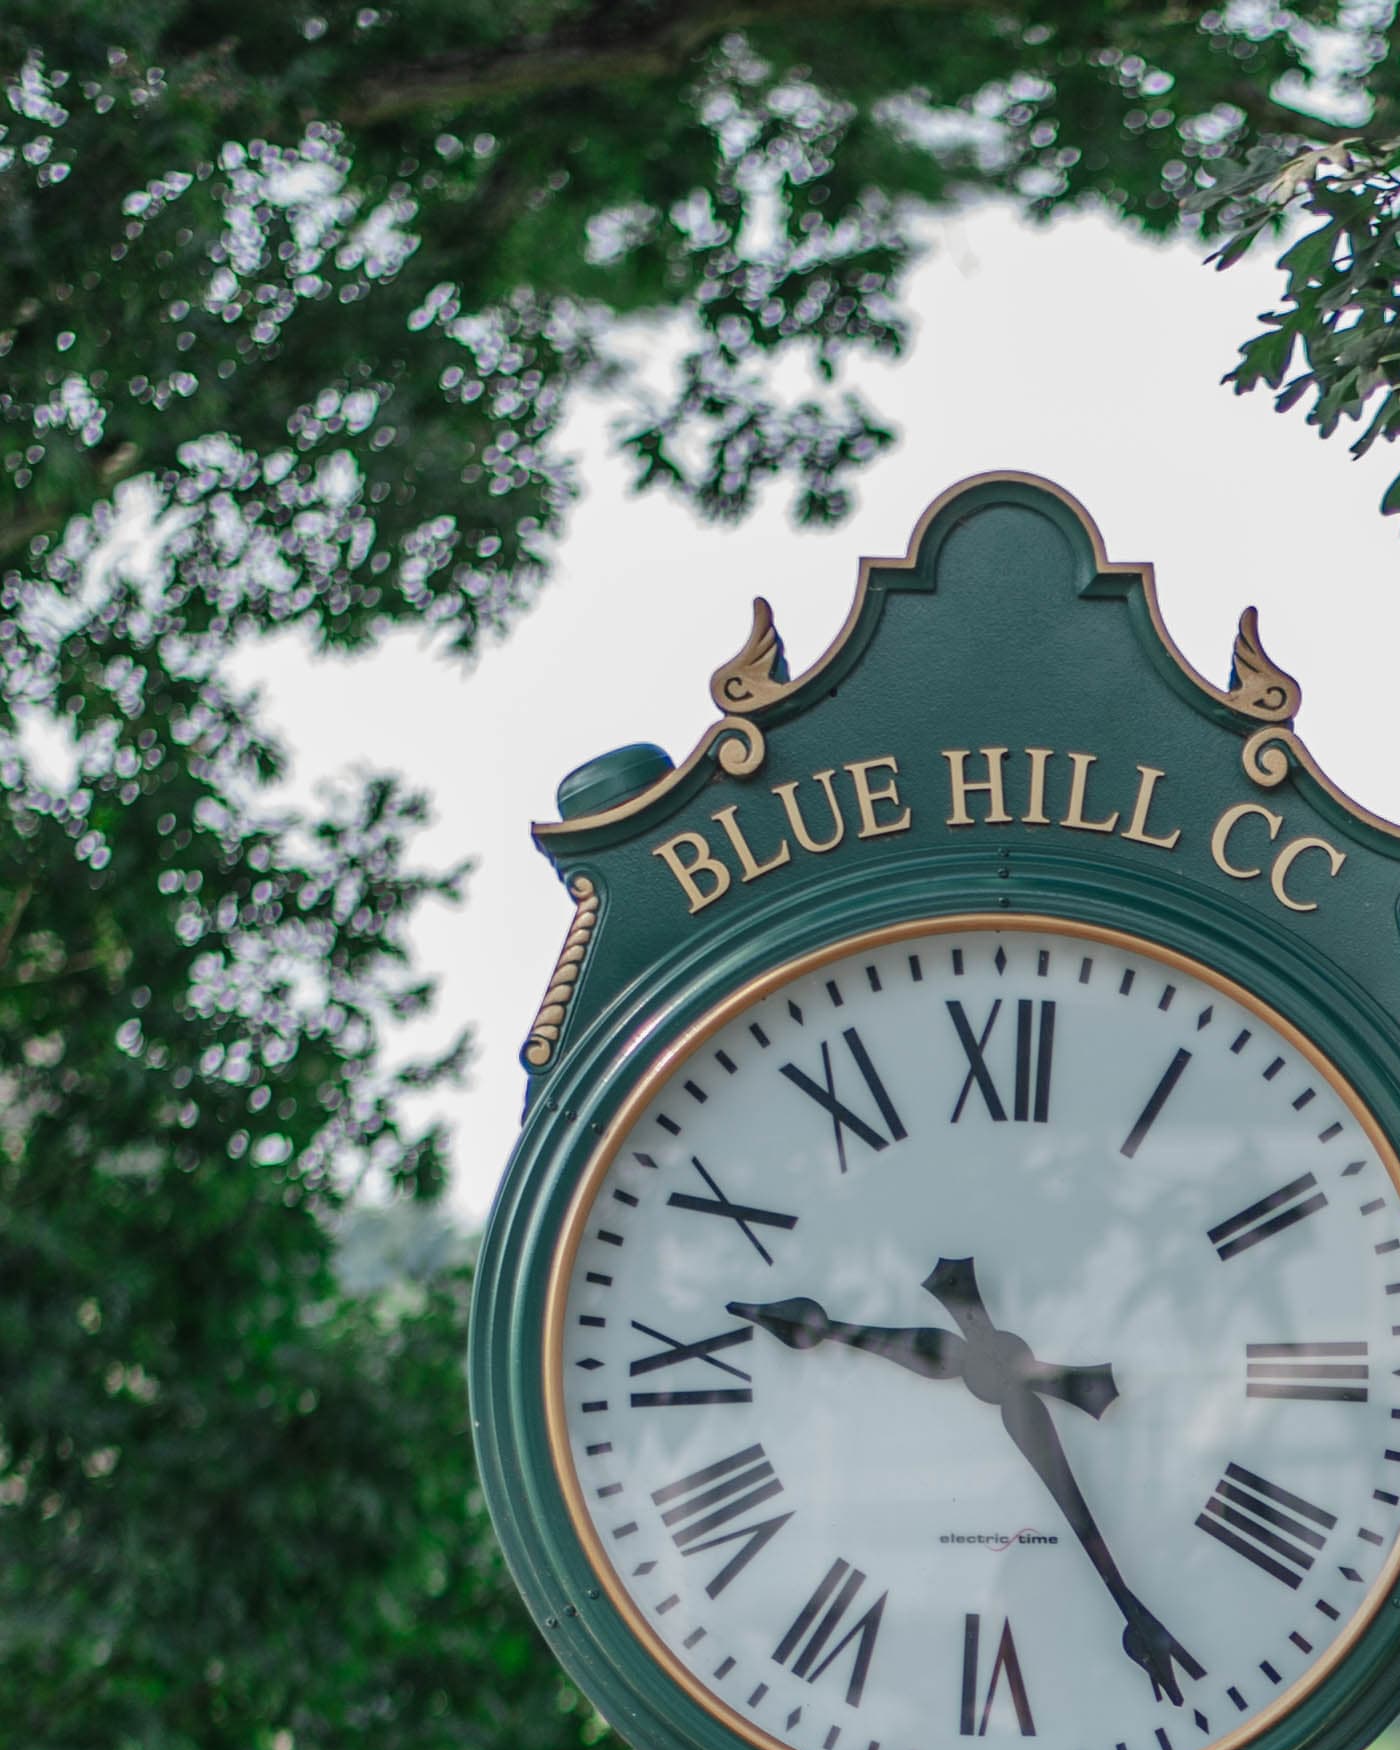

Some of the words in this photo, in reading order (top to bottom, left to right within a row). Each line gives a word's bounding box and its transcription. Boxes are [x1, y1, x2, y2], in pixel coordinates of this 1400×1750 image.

[654, 756, 911, 914] BLUE
[942, 748, 1180, 850] HILL
[1212, 802, 1347, 912] CC
[780, 1028, 908, 1173] XI
[946, 999, 1056, 1124] XII
[1120, 1048, 1192, 1158] I
[667, 1156, 799, 1266] X
[1207, 1172, 1328, 1262] II
[630, 1319, 753, 1408] IX
[1246, 1341, 1369, 1403] III
[650, 1443, 796, 1600] VIII
[939, 1532, 1010, 1545] electric
[1018, 1533, 1059, 1545] time
[1194, 1461, 1338, 1590] IIII
[770, 1557, 889, 1708] VII
[959, 1613, 1037, 1737] VI
